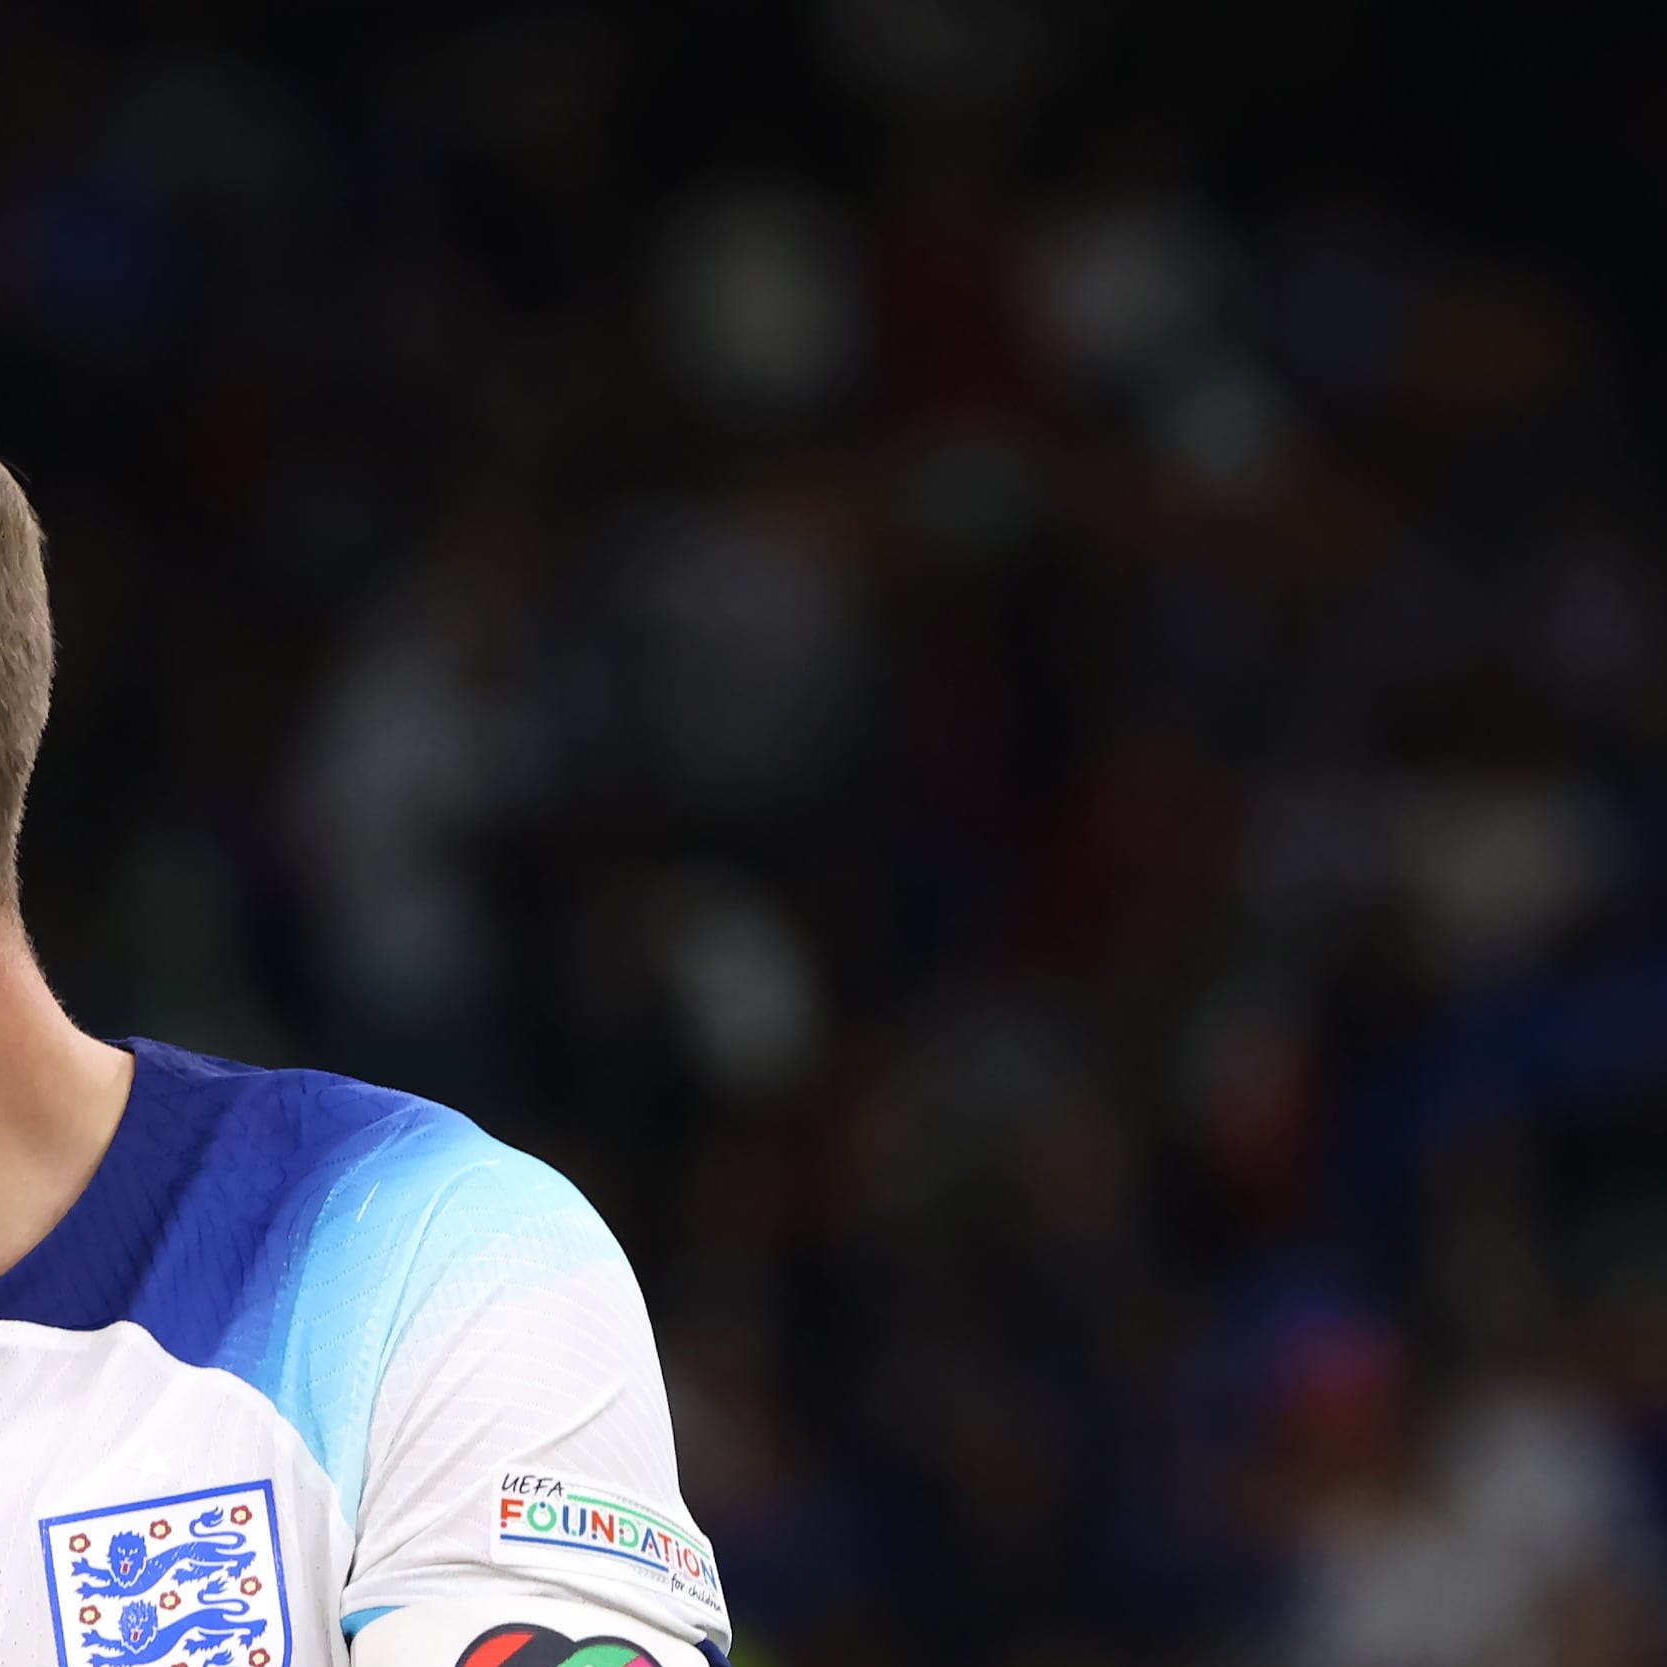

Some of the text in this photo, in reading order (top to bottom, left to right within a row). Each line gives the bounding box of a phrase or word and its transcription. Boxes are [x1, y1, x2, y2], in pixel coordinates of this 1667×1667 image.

[501, 1472, 565, 1498] UEFA
[499, 1497, 718, 1592] FOUNDATION
[670, 1572, 685, 1593] for
